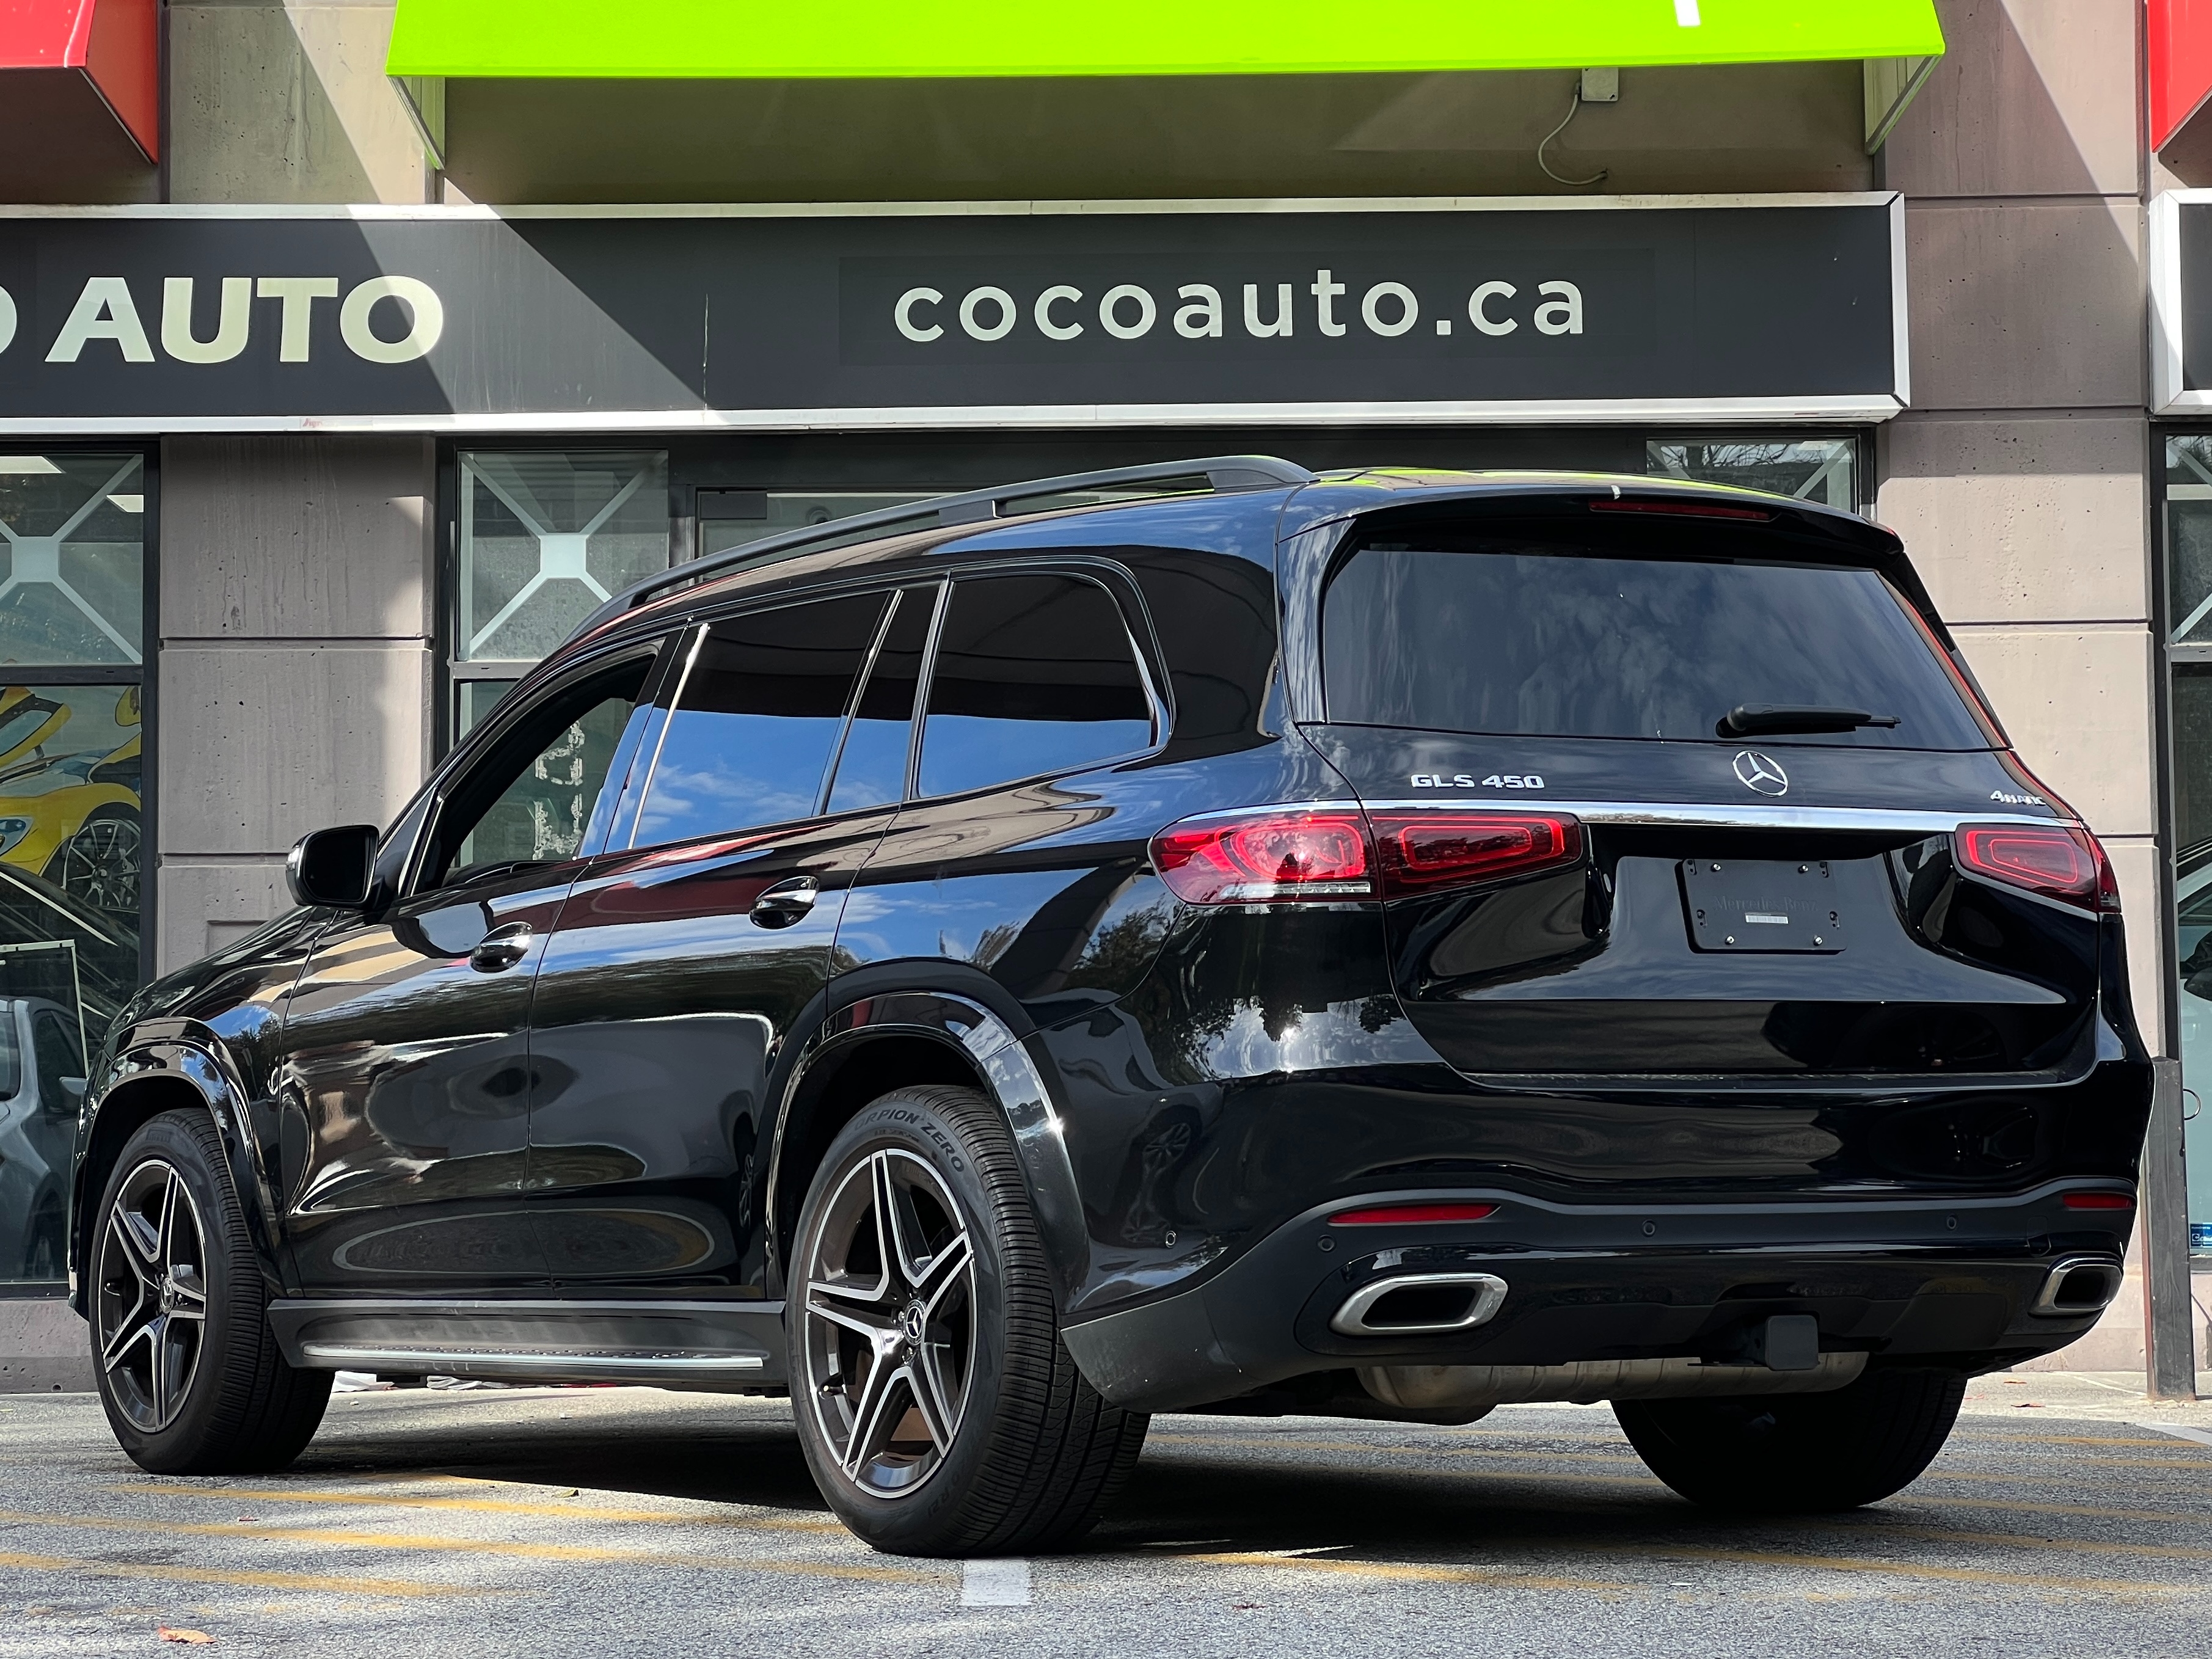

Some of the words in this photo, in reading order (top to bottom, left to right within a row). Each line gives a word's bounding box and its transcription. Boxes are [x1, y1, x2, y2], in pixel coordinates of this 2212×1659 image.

[45, 275, 445, 363] AUTO
[895, 270, 1582, 341] cocoauto.ca
[1411, 775, 1474, 787] GLS
[1482, 776, 1544, 788] 450
[1712, 895, 1819, 911] Mercedes-Benz
[847, 1109, 920, 1136] ORPION
[920, 1122, 965, 1172] ZERO
